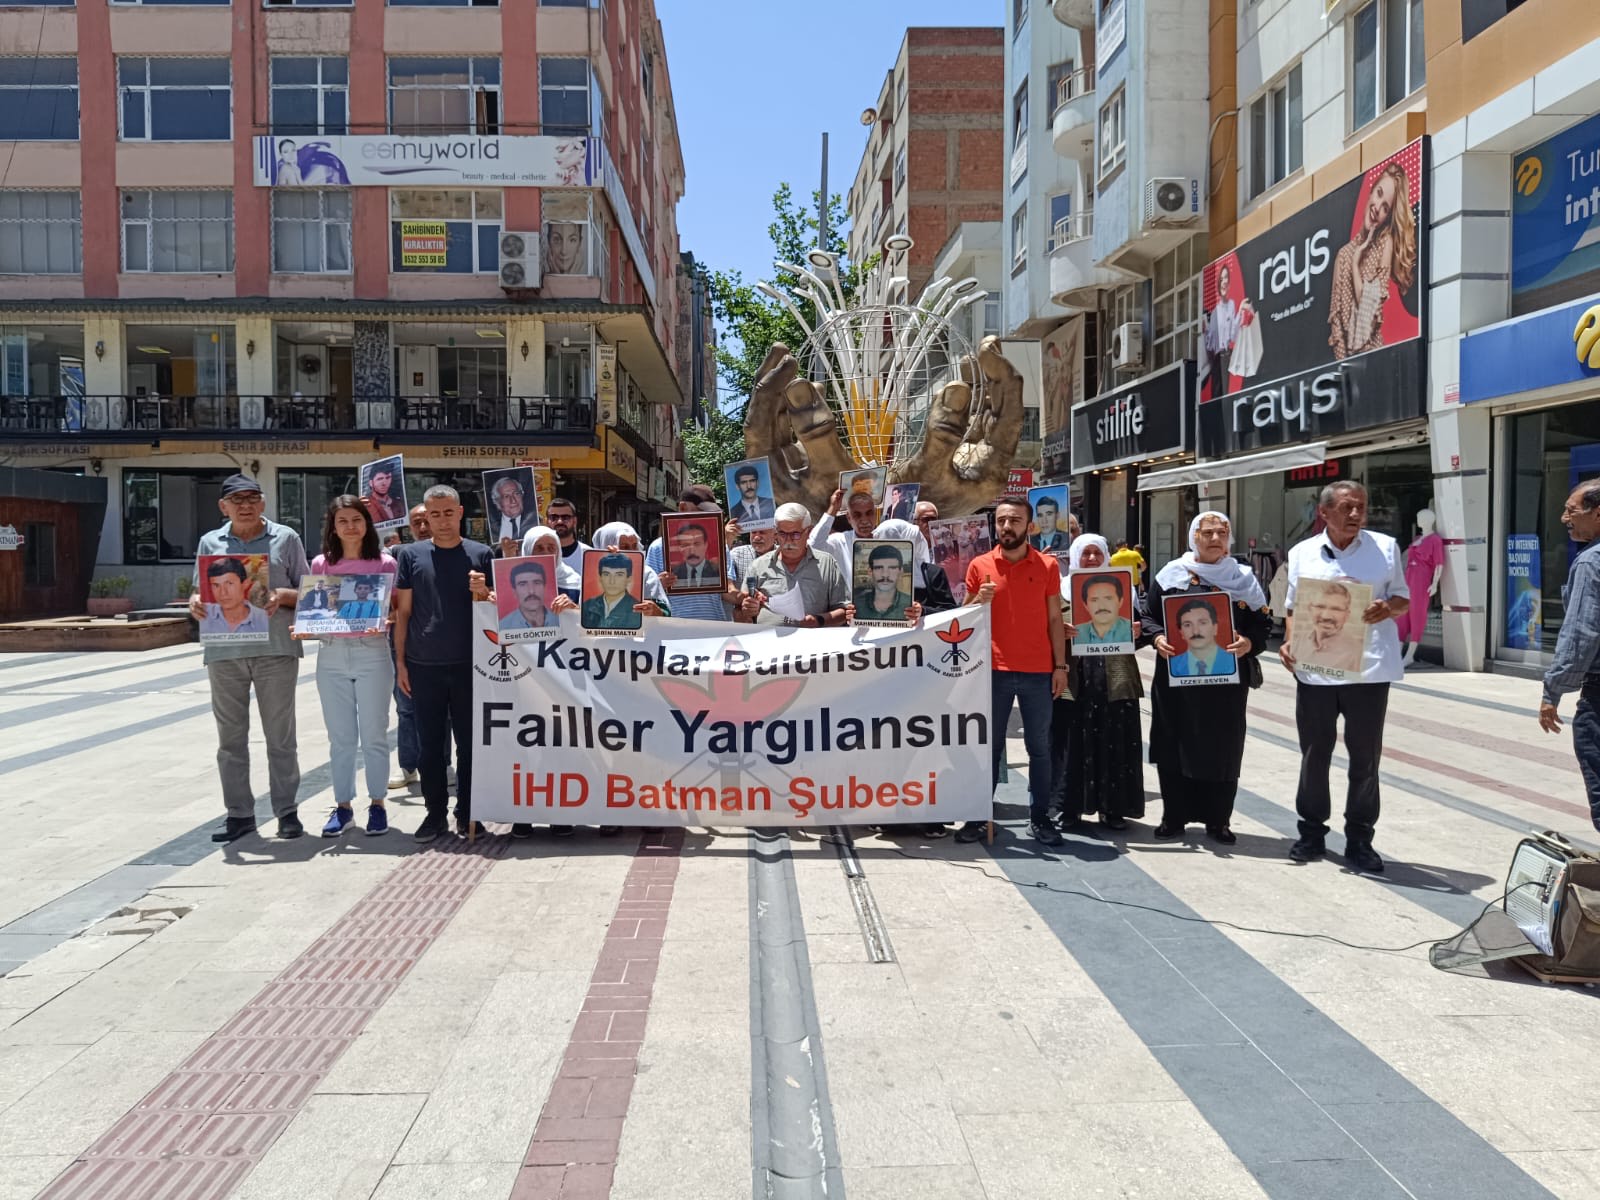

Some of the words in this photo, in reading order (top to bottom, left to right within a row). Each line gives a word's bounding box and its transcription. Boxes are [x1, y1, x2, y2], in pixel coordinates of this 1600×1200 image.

[361, 138, 499, 164] esmyworld
[1191, 179, 1199, 213] BEKO
[1259, 229, 1330, 300] rays
[1233, 371, 1338, 432] rays
[1096, 393, 1144, 445] stilife
[41, 446, 90, 456] SOFRASI
[259, 441, 310, 452] SOFRASI
[442, 446, 477, 457] ŞEHİR
[480, 446, 529, 457] SOFRASI
[537, 638, 710, 682] Kayıplar
[722, 643, 923, 677] Bulunsun
[1087, 645, 1100, 653] İSA
[1103, 645, 1120, 653] GÖK
[1302, 663, 1325, 674] TAHİR
[1326, 668, 1345, 678] ELÇİ
[482, 702, 655, 753] Failler
[670, 707, 988, 765] Yargılansın
[513, 763, 590, 808] İHD
[606, 773, 772, 812] Batman
[787, 771, 937, 818] Şubesi
